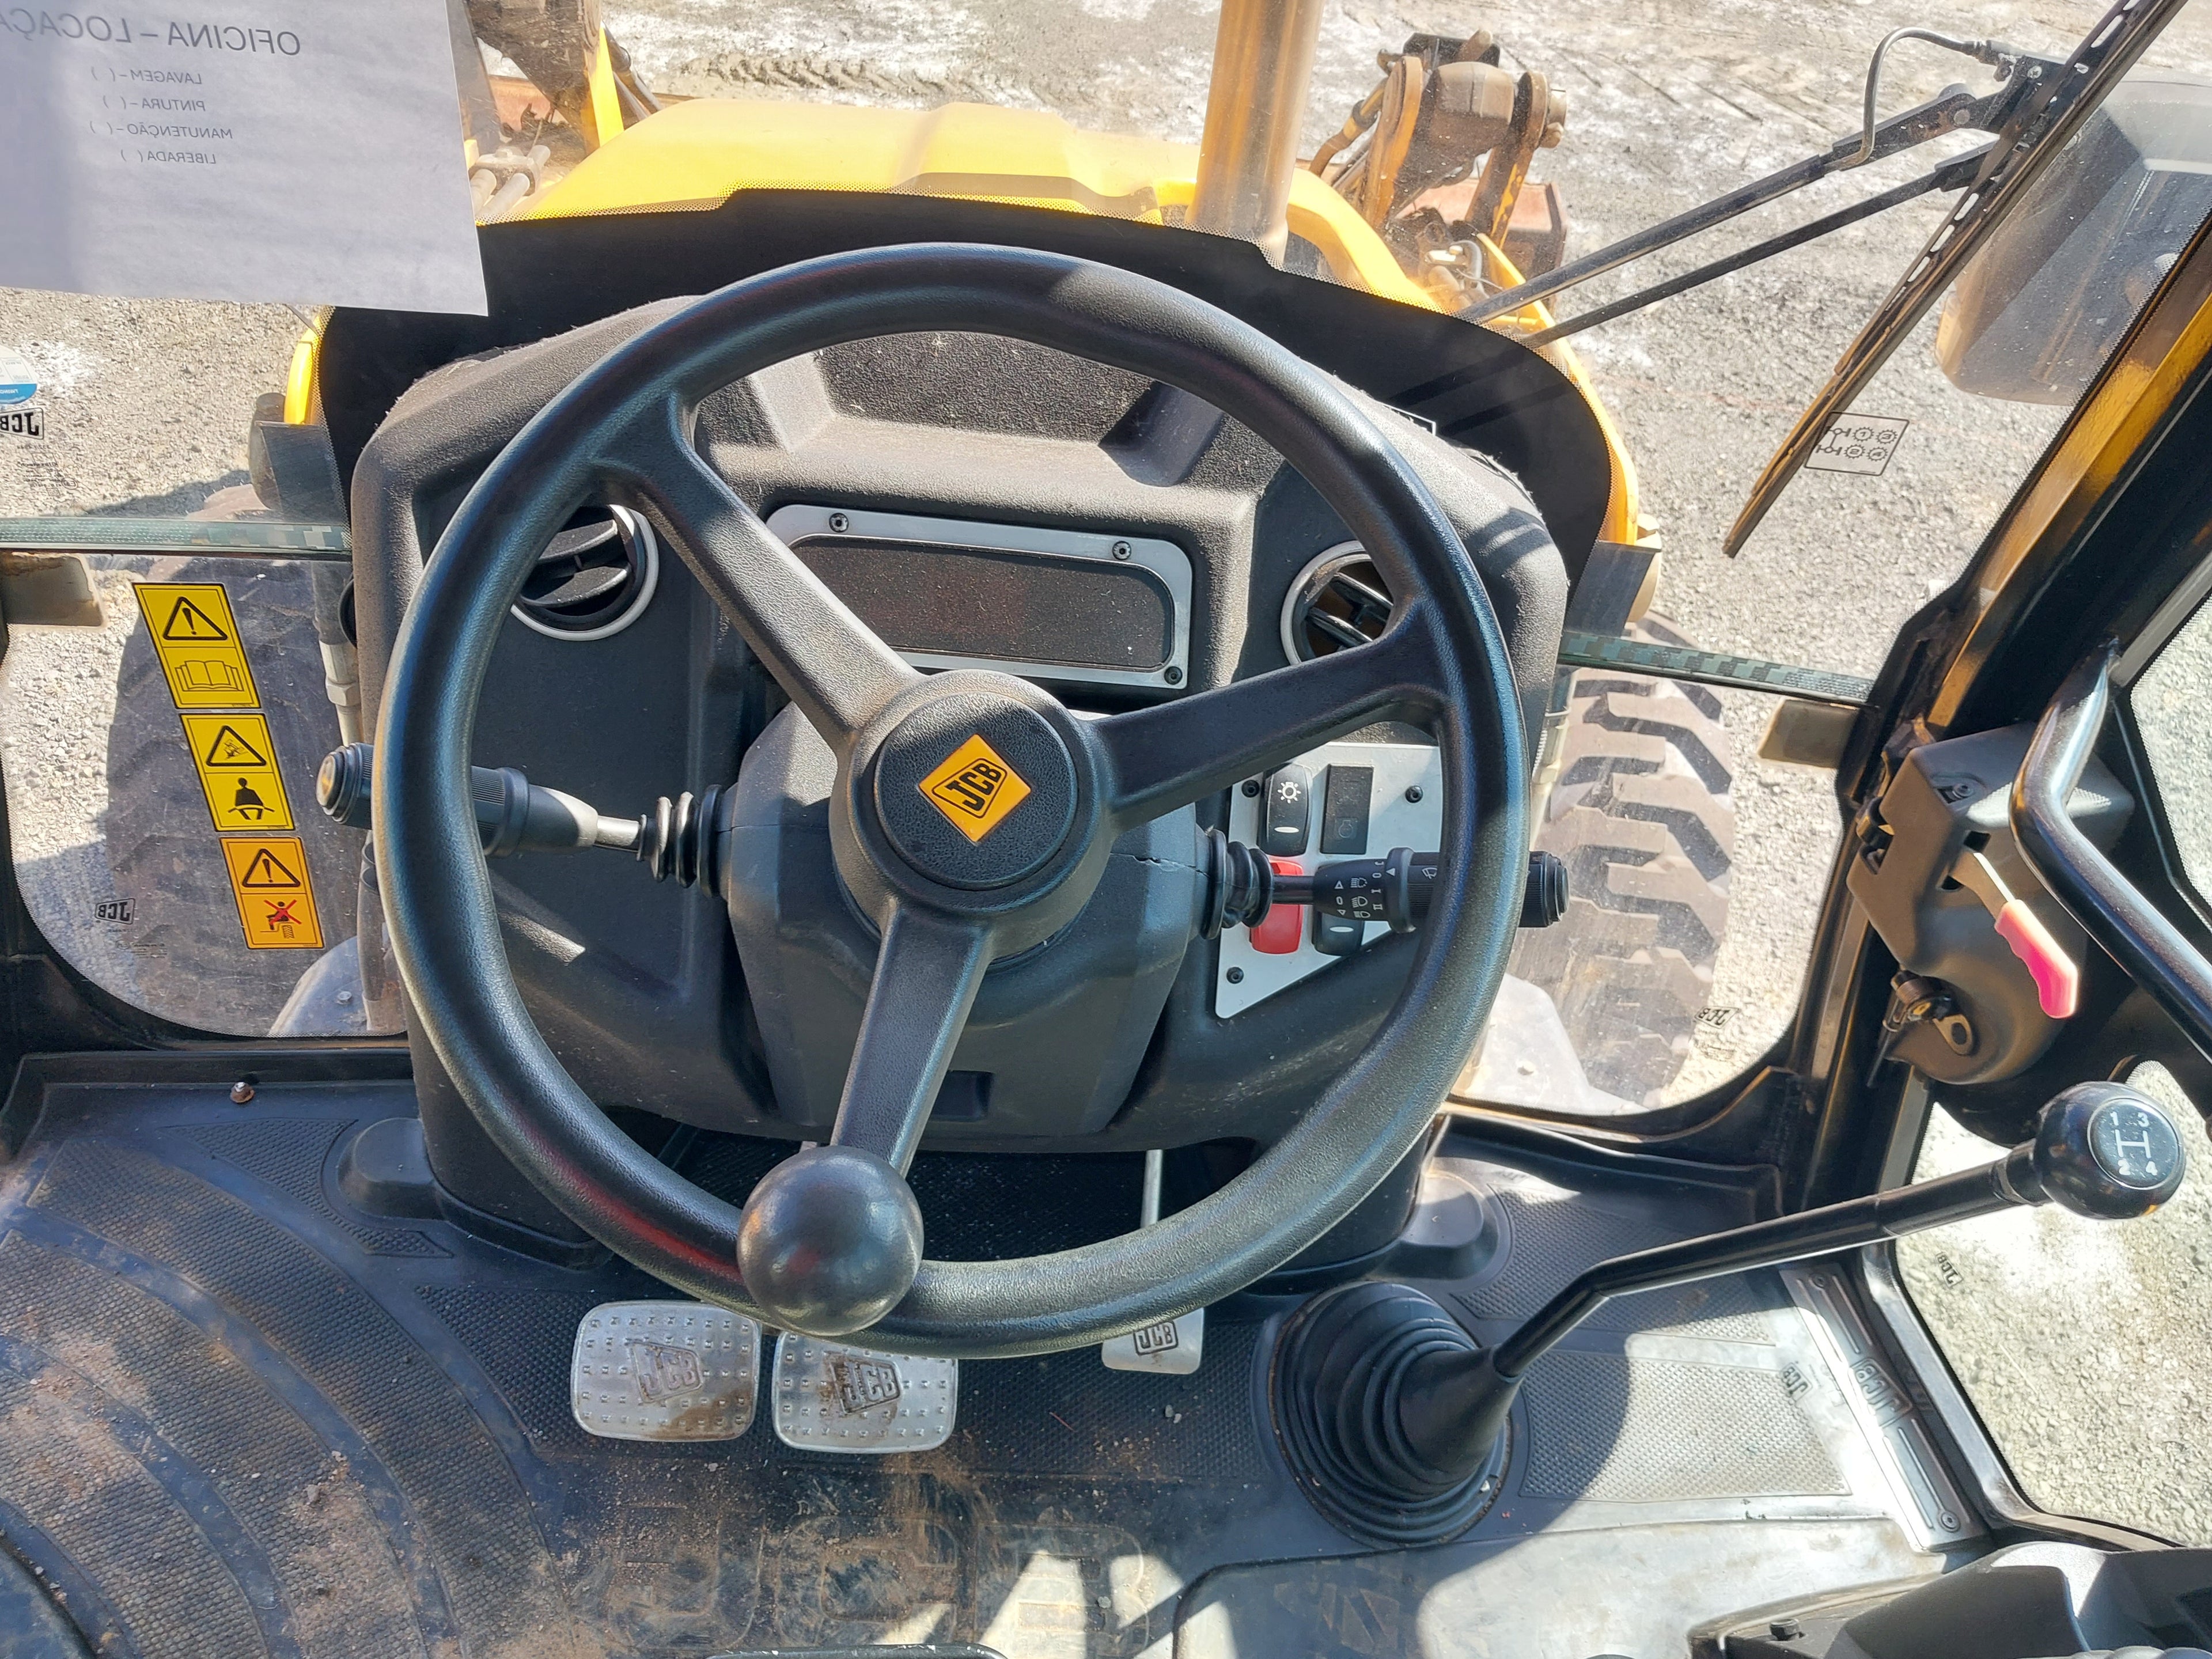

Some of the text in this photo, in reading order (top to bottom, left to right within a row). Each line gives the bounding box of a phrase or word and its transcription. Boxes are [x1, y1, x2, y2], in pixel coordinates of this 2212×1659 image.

[944, 763, 1003, 812] JCB
[2109, 1111, 2150, 1127] 1 3
[2118, 1160, 2158, 1176] 2 4
[1139, 1324, 1173, 1350] JCB
[642, 1351, 702, 1395] JCB
[843, 1362, 899, 1411] JCB
[1854, 1363, 1902, 1417] JCB
